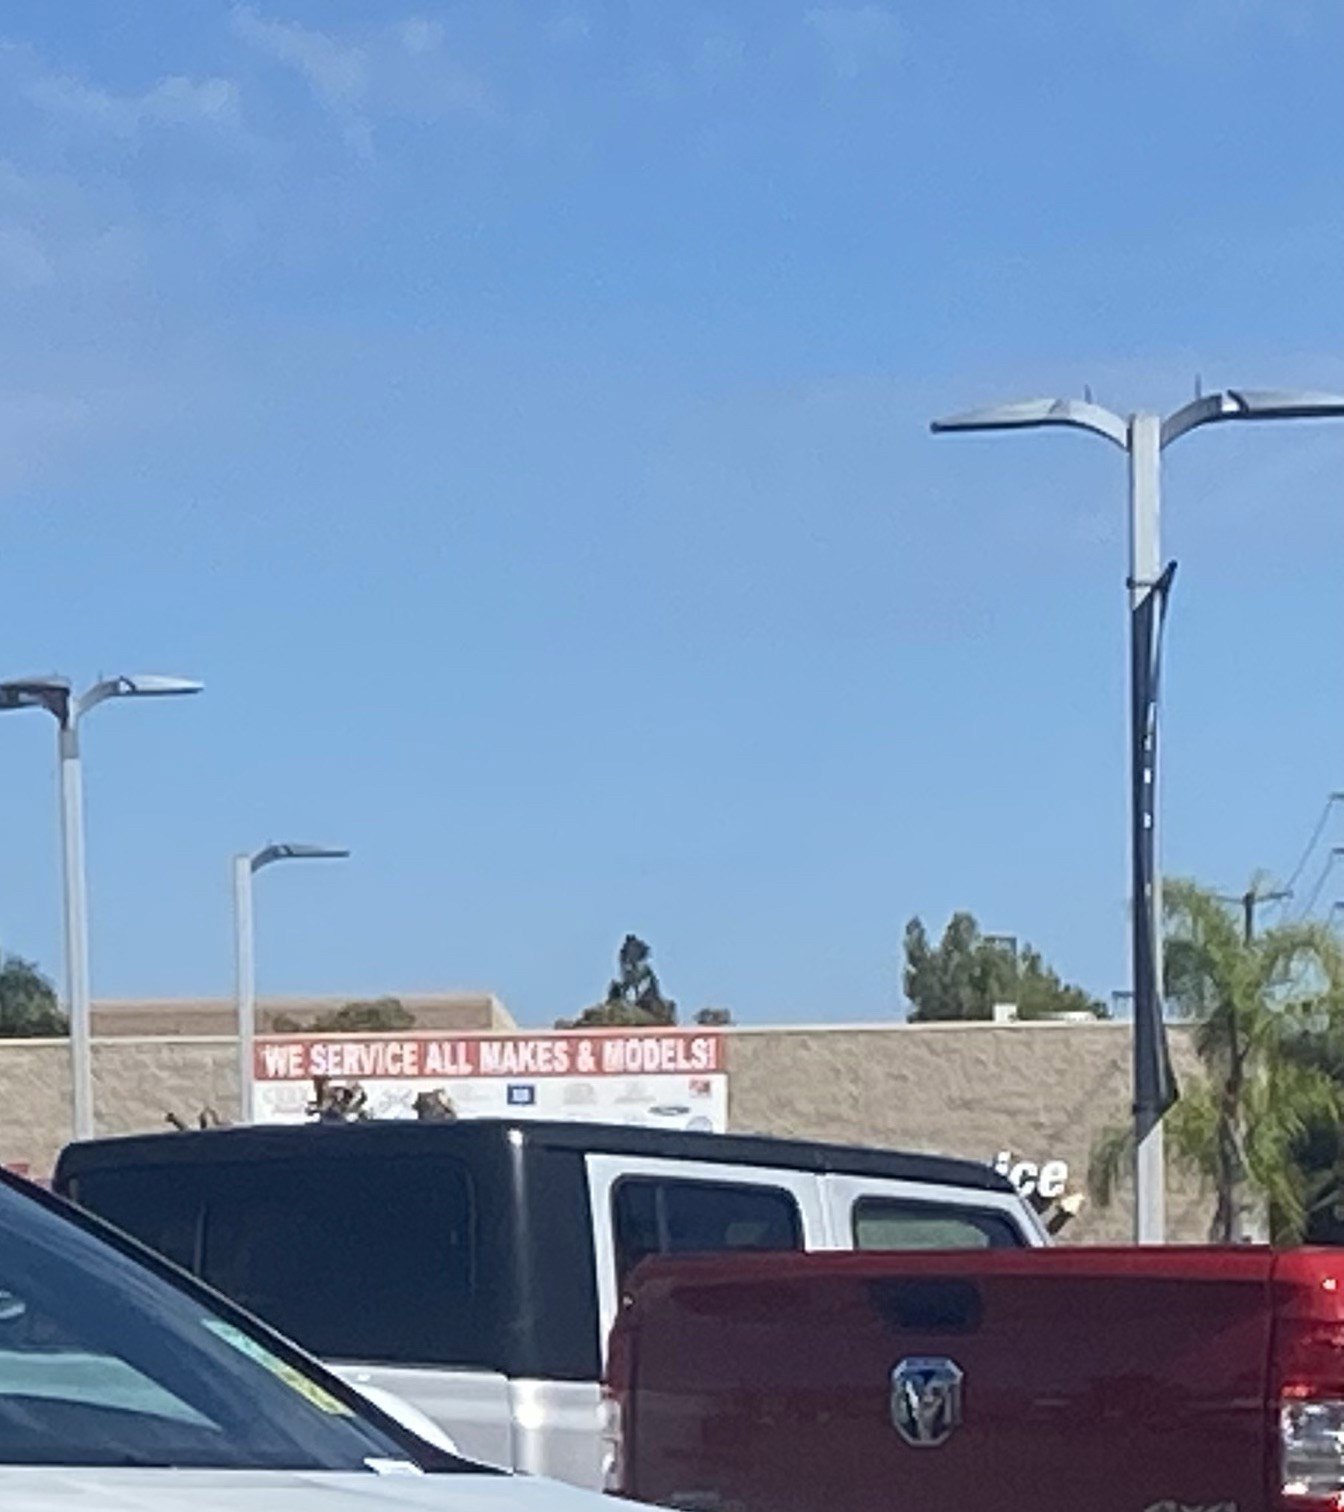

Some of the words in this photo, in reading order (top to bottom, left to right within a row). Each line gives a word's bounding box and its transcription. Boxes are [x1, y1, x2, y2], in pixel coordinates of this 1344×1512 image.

[263, 1043, 306, 1078] WE
[310, 1041, 419, 1076] SERVICE
[426, 1040, 473, 1075] ALL
[479, 1040, 570, 1075] MAKES
[576, 1039, 596, 1073] &
[602, 1036, 718, 1073] MODELS!
